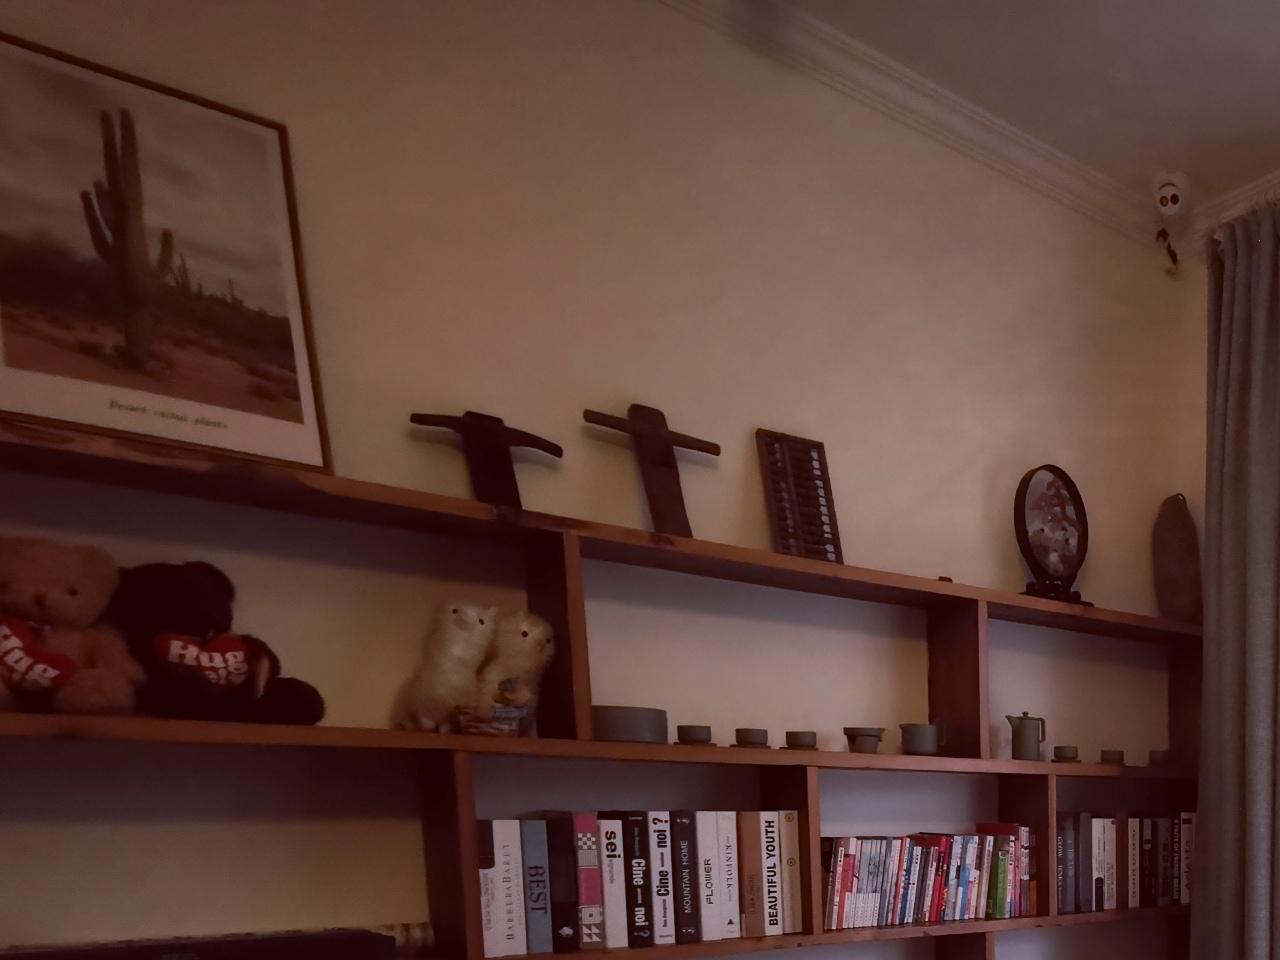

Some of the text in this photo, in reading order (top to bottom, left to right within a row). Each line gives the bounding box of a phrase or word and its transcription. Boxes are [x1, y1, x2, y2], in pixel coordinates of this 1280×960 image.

[605, 830, 621, 859] sei
[653, 829, 667, 848] noi
[631, 858, 646, 886] Cine
[656, 870, 670, 897] Cine
[680, 840, 692, 913] MOUNTAIN HOME
[704, 858, 714, 905] FLOWER
[725, 844, 734, 889] KINFOLK
[764, 820, 778, 926] BEAUTIFUL YOUTH
[527, 864, 548, 915] BEST
[634, 907, 649, 926] noi
